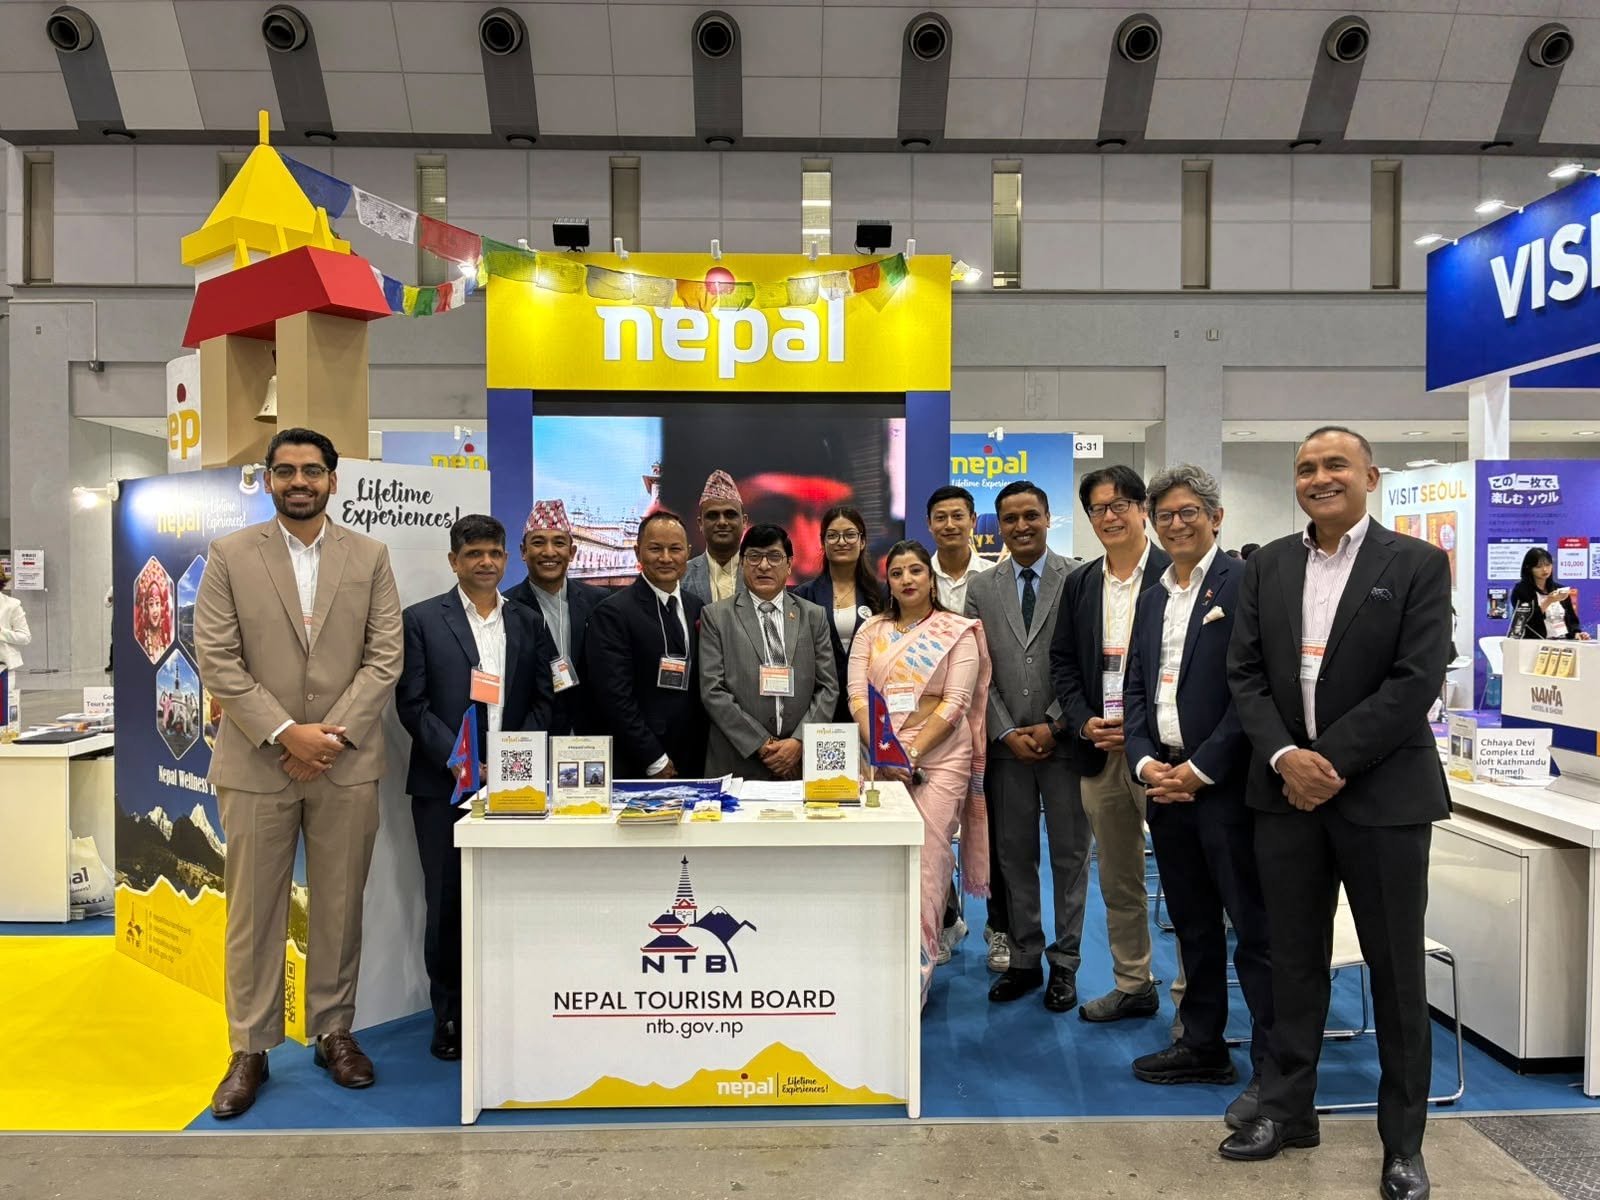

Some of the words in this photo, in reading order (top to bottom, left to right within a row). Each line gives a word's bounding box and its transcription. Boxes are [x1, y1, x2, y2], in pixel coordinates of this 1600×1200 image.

[595, 290, 845, 379] nepal
[1075, 442, 1098, 451] G-31
[950, 450, 1028, 479] nepal
[356, 477, 434, 511] Lifetime
[1388, 486, 1419, 505] VISIT
[1420, 480, 1468, 503] SEOUL
[157, 504, 201, 538] nepal
[342, 500, 460, 533] Experiences!
[1531, 685, 1563, 707] NANTA
[1480, 738, 1513, 748] Chhaya
[1515, 738, 1536, 746] Devi
[1480, 749, 1518, 758] Complex
[1496, 758, 1547, 766] Kathmandu
[158, 765, 178, 786] Nepal
[178, 769, 209, 794] Wellness
[1488, 768, 1524, 776] Thamel)
[70, 866, 90, 884] al
[642, 955, 727, 974] NTB
[554, 991, 627, 1010] NEPAL
[634, 990, 743, 1010] TOURISM
[751, 990, 836, 1009] BOARD
[646, 1018, 743, 1038] ntb.gov.np
[716, 1077, 774, 1099] nepal
[782, 1084, 829, 1096] Experiences!
[787, 1076, 817, 1086] Lifetime
